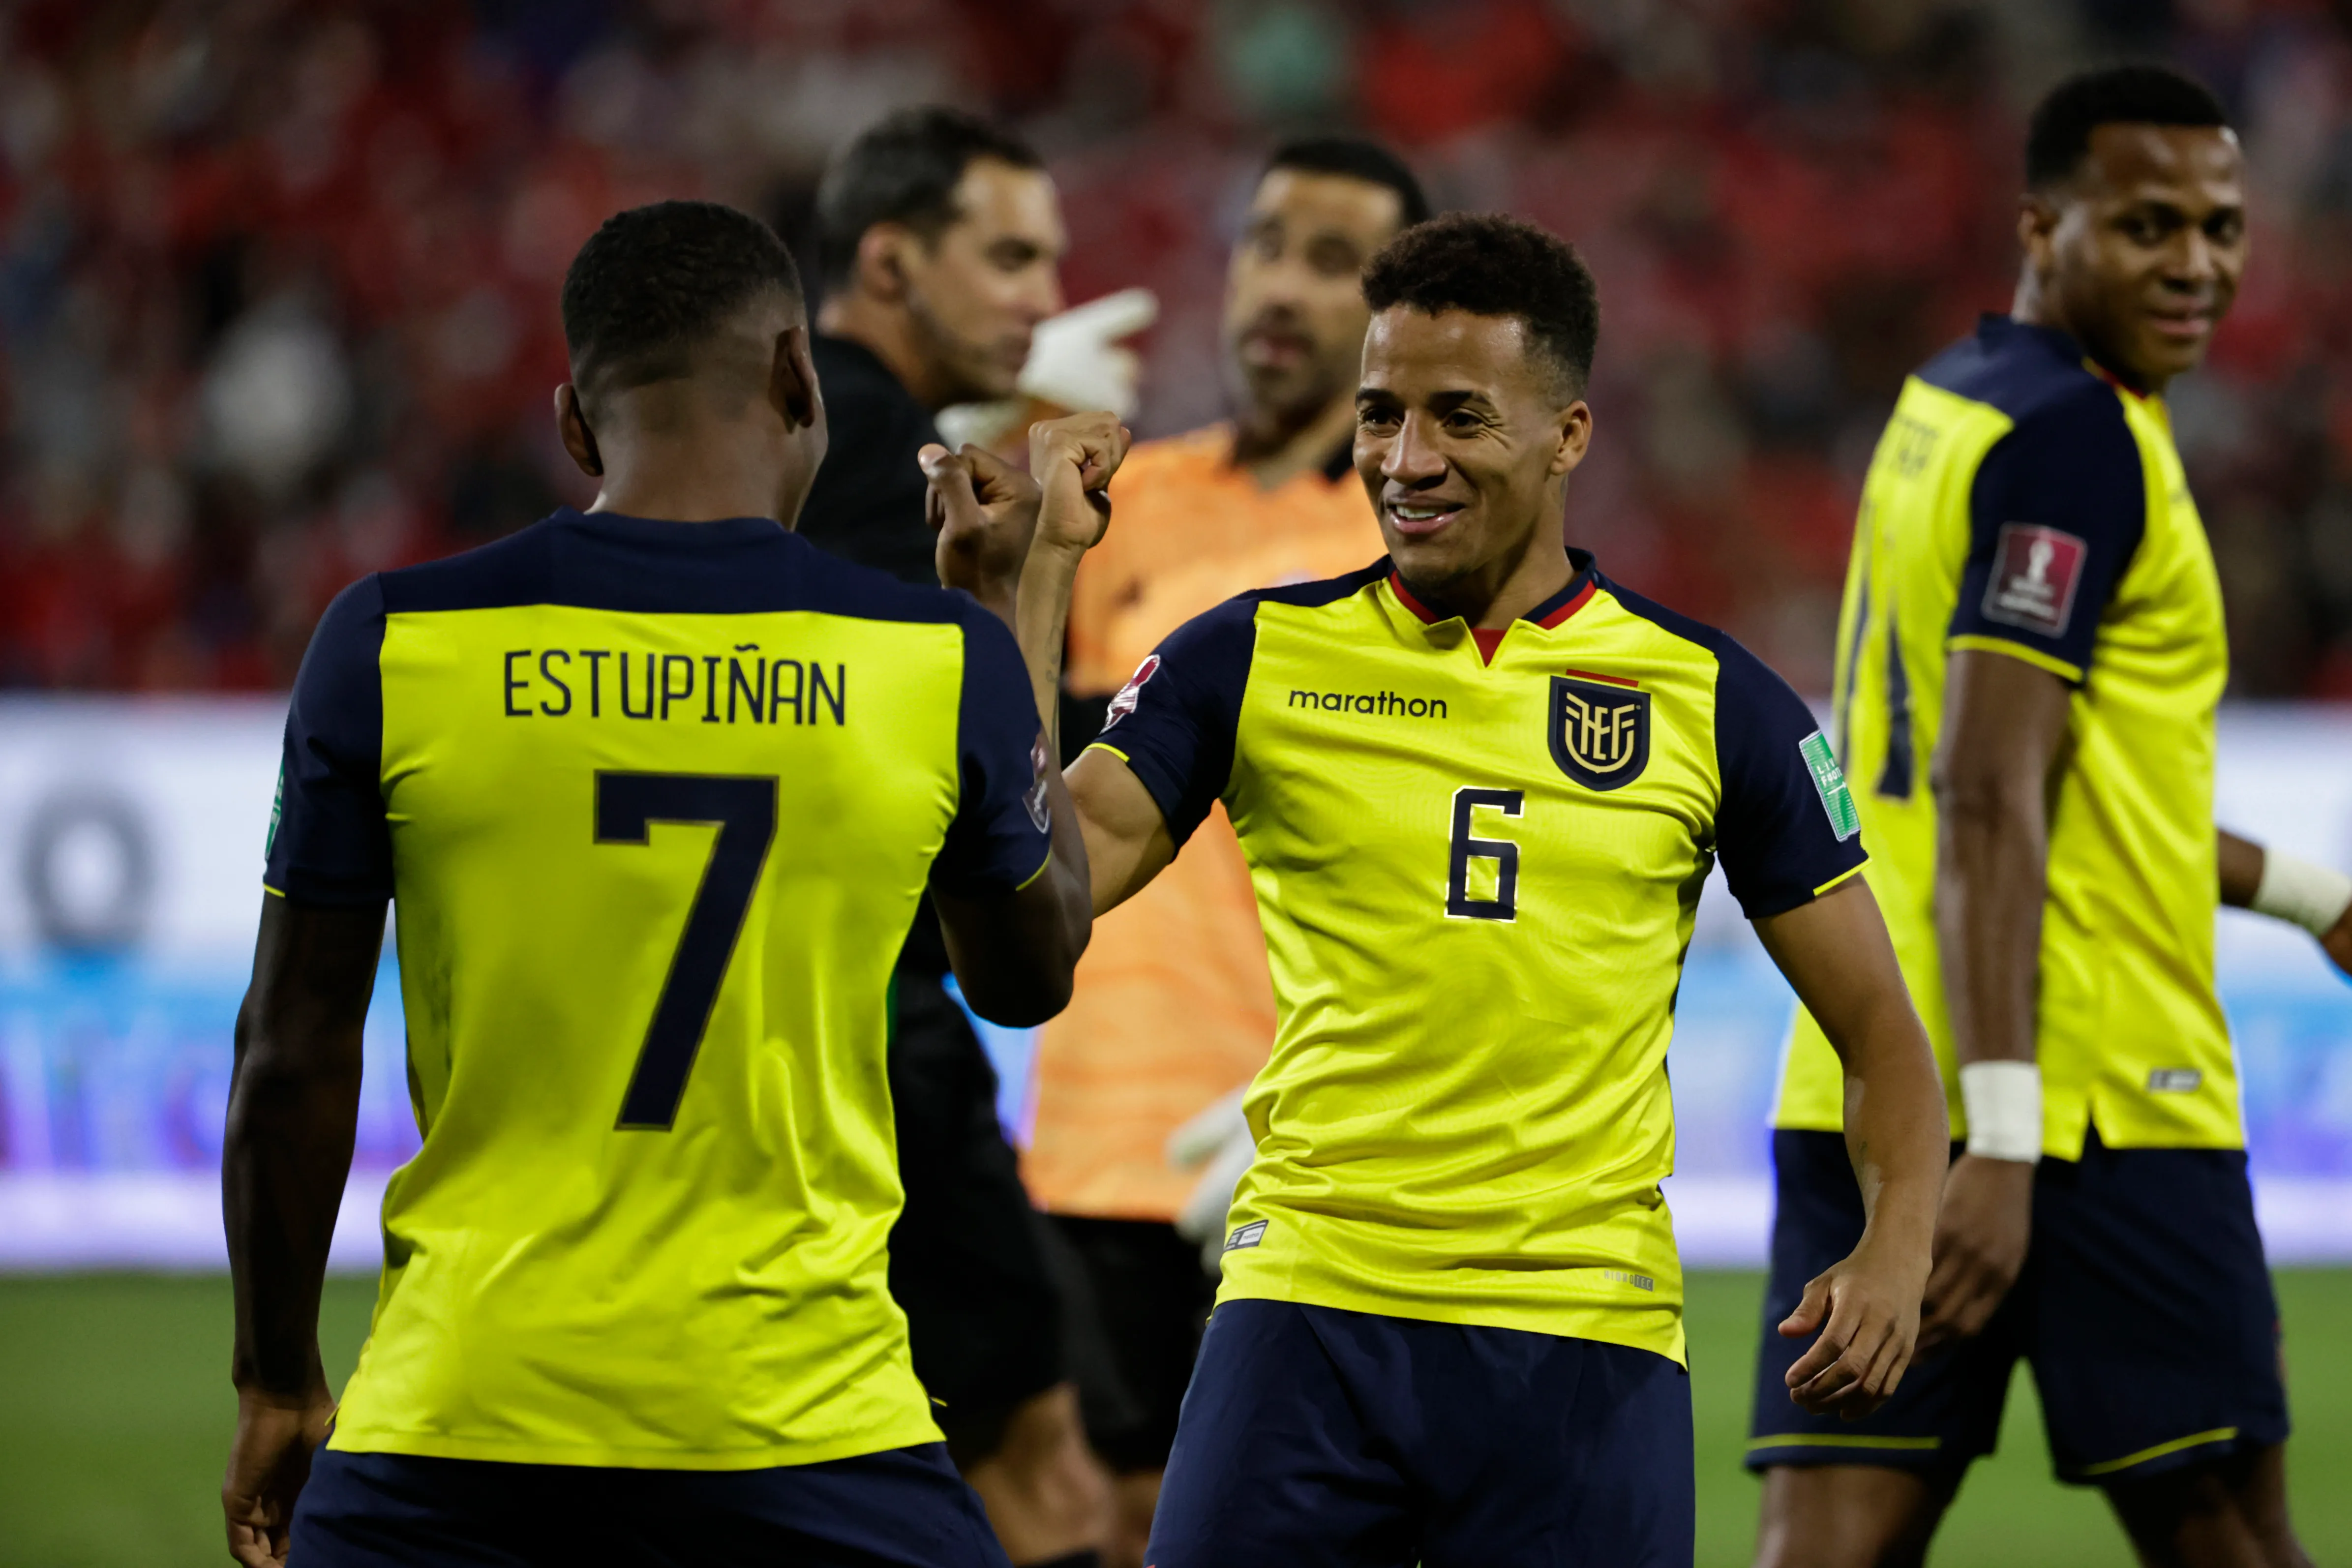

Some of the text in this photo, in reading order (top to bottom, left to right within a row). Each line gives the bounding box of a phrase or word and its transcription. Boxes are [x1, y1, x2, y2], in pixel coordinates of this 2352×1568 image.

[504, 643, 845, 726] ESTUPIÑAN
[1288, 690, 1447, 719] marathon
[1444, 784, 1525, 923] 6
[593, 769, 780, 1133] 7
